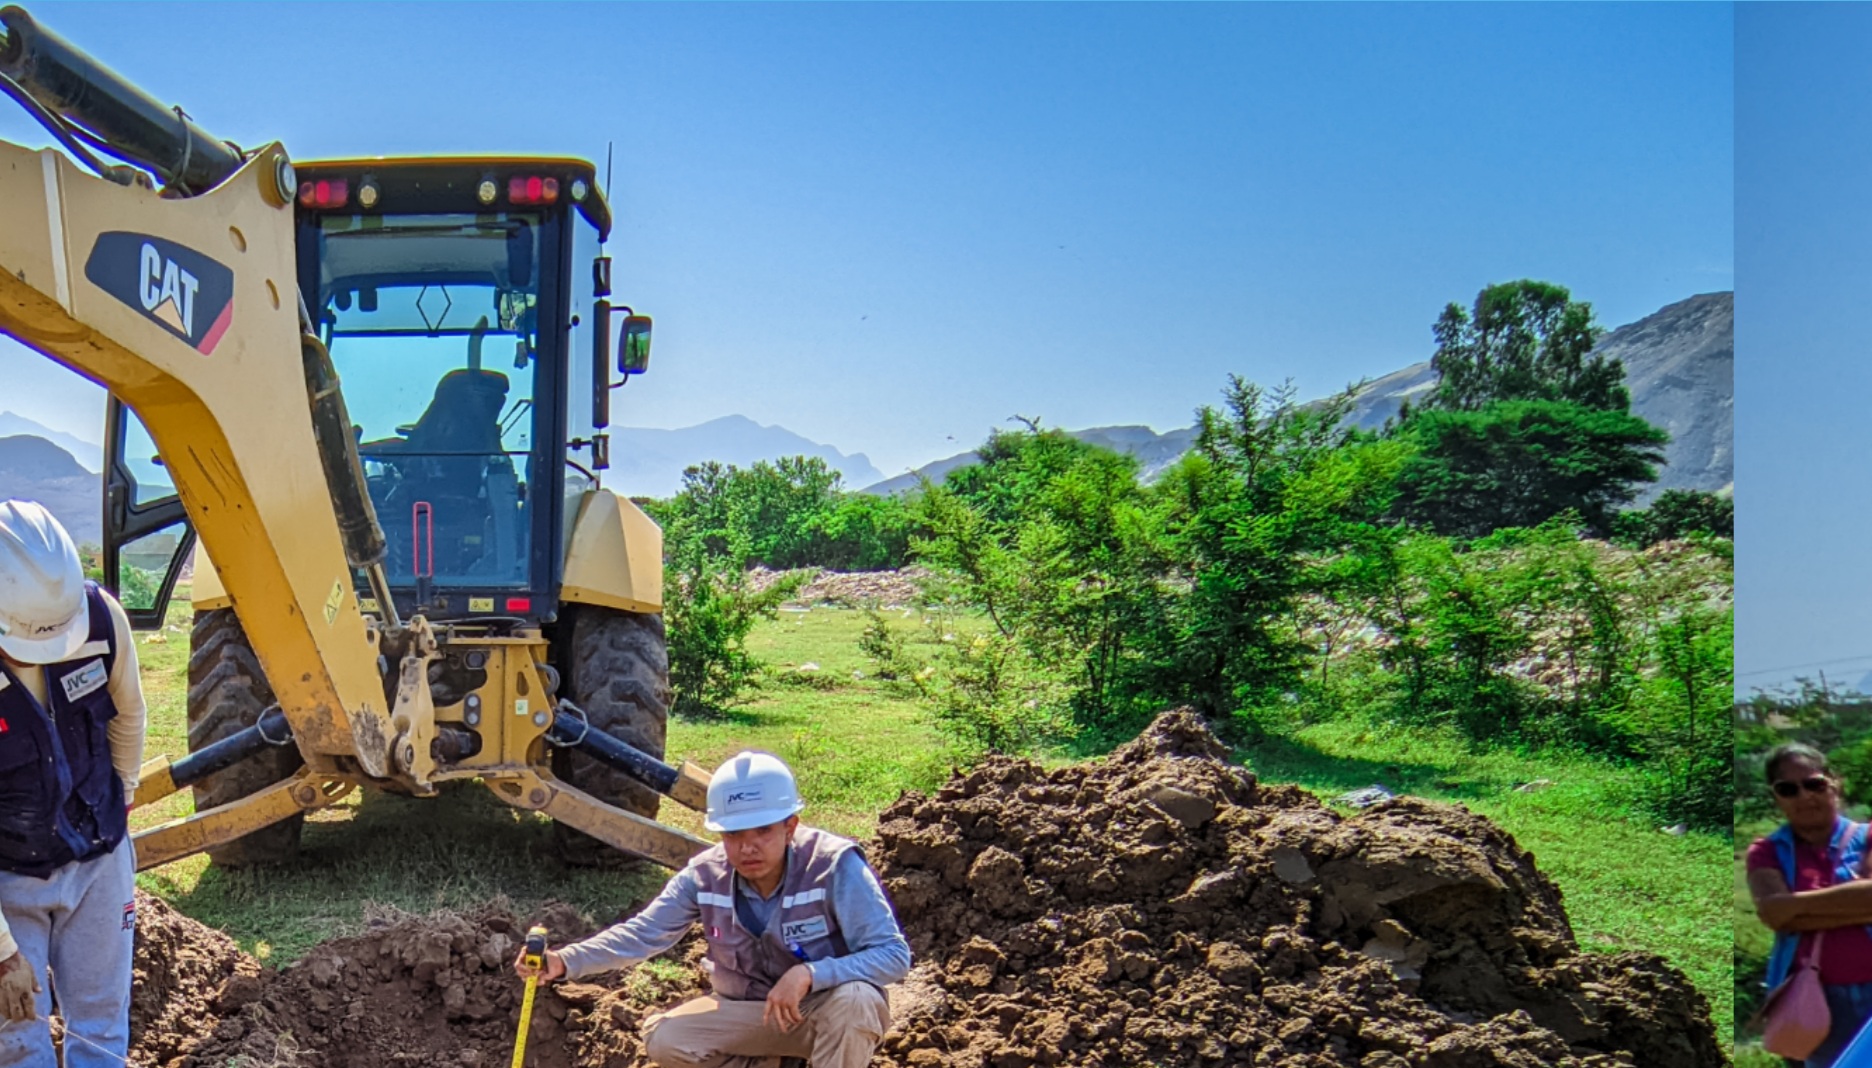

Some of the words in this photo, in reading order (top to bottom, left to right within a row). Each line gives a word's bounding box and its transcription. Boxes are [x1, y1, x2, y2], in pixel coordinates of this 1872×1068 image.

[140, 242, 199, 338] CAT
[67, 672, 88, 692] JVC
[786, 923, 806, 936] JVC
